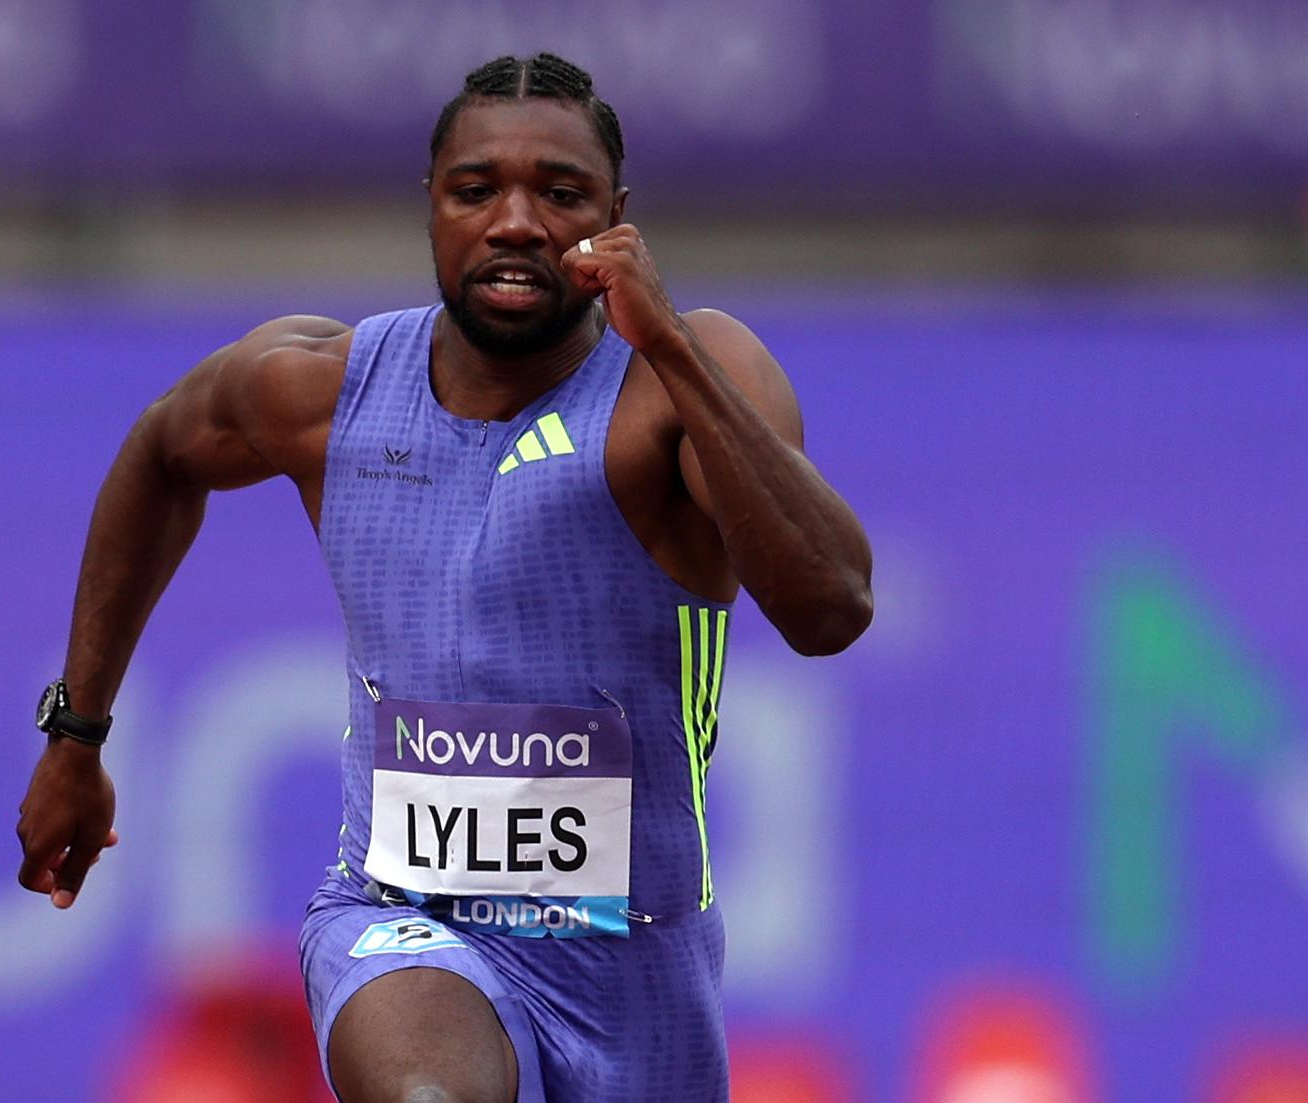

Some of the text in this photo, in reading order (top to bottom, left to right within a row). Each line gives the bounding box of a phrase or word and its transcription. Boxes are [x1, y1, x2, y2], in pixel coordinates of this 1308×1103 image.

[395, 716, 590, 767] Novuna
[406, 802, 588, 872] LYLES
[452, 899, 590, 930] LONDON
